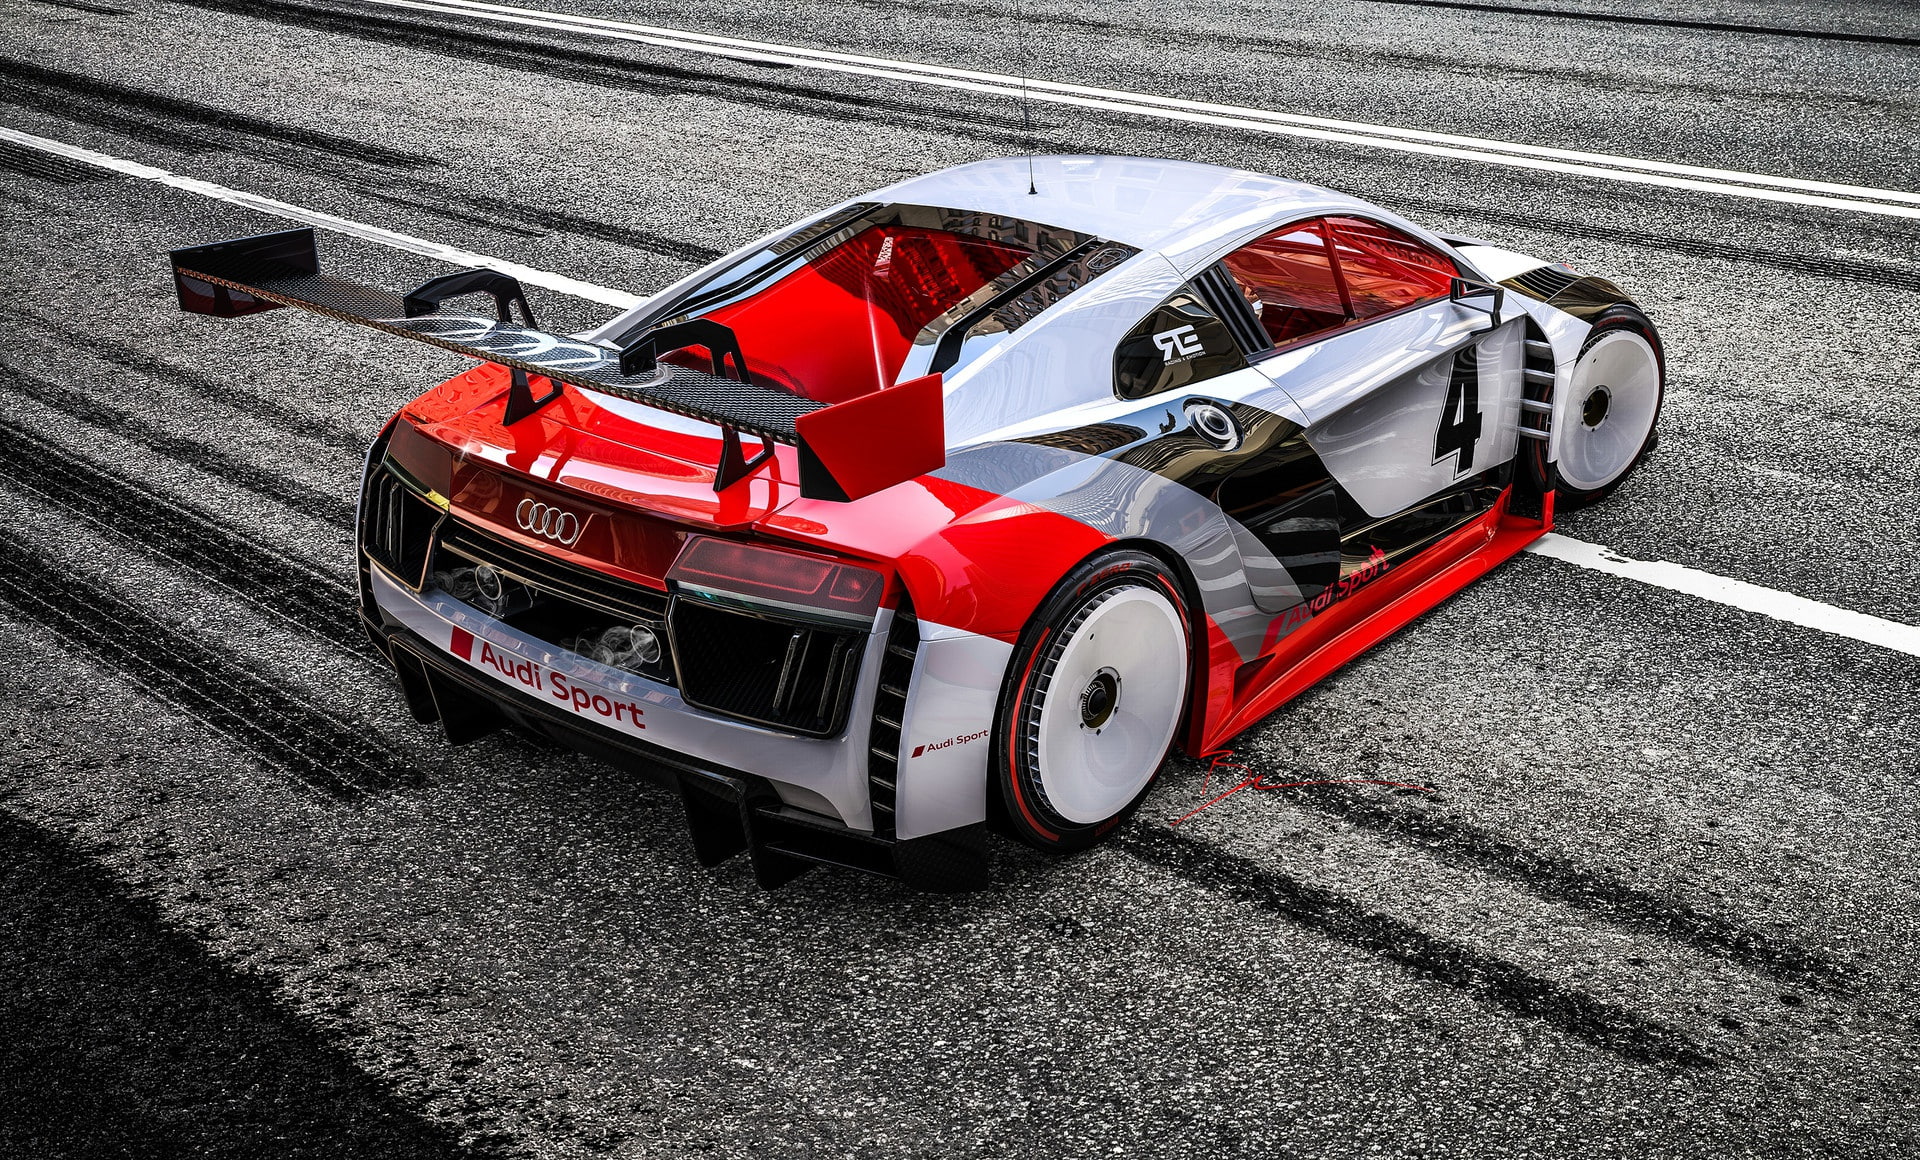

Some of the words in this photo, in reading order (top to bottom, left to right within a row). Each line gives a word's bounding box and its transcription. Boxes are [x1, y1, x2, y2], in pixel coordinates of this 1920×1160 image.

[1431, 343, 1483, 481] 4
[1285, 582, 1335, 632] Audi
[480, 641, 543, 691] Audi
[549, 671, 647, 730] Sport
[926, 737, 954, 753] Audi
[956, 729, 989, 745] Sport
